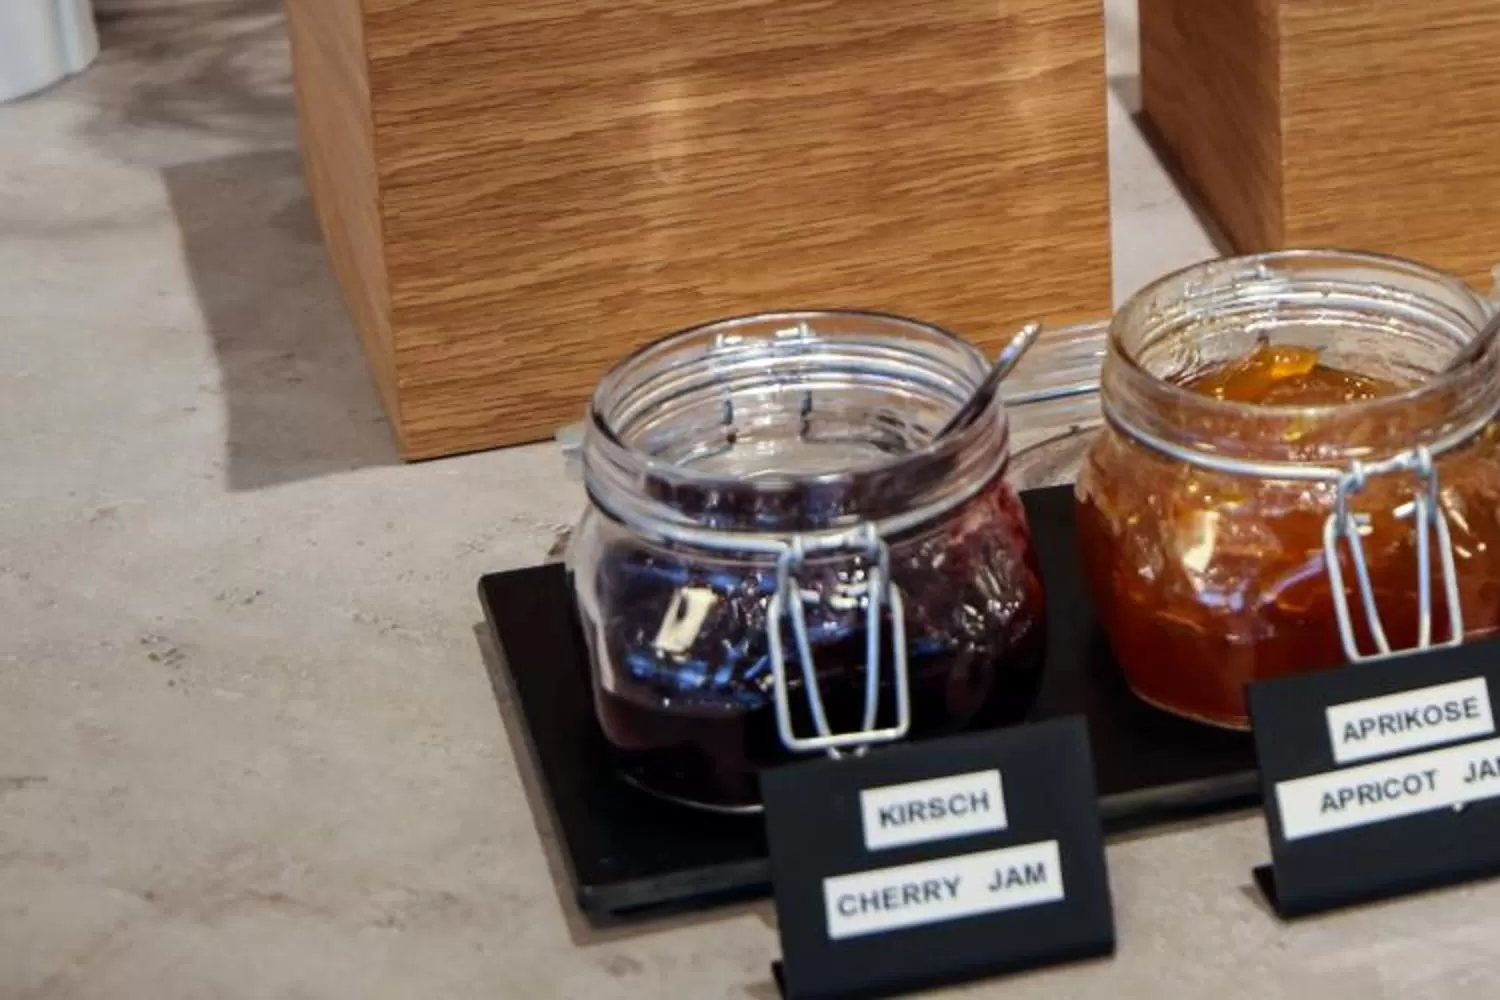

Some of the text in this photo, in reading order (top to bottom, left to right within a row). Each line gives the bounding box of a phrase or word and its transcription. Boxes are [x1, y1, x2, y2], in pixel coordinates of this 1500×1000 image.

[1342, 698, 1481, 743] APRIKOSE
[877, 790, 991, 828] KIRSCH
[1319, 769, 1438, 814] APRICOT
[836, 863, 1047, 917] CHERRY JAM
